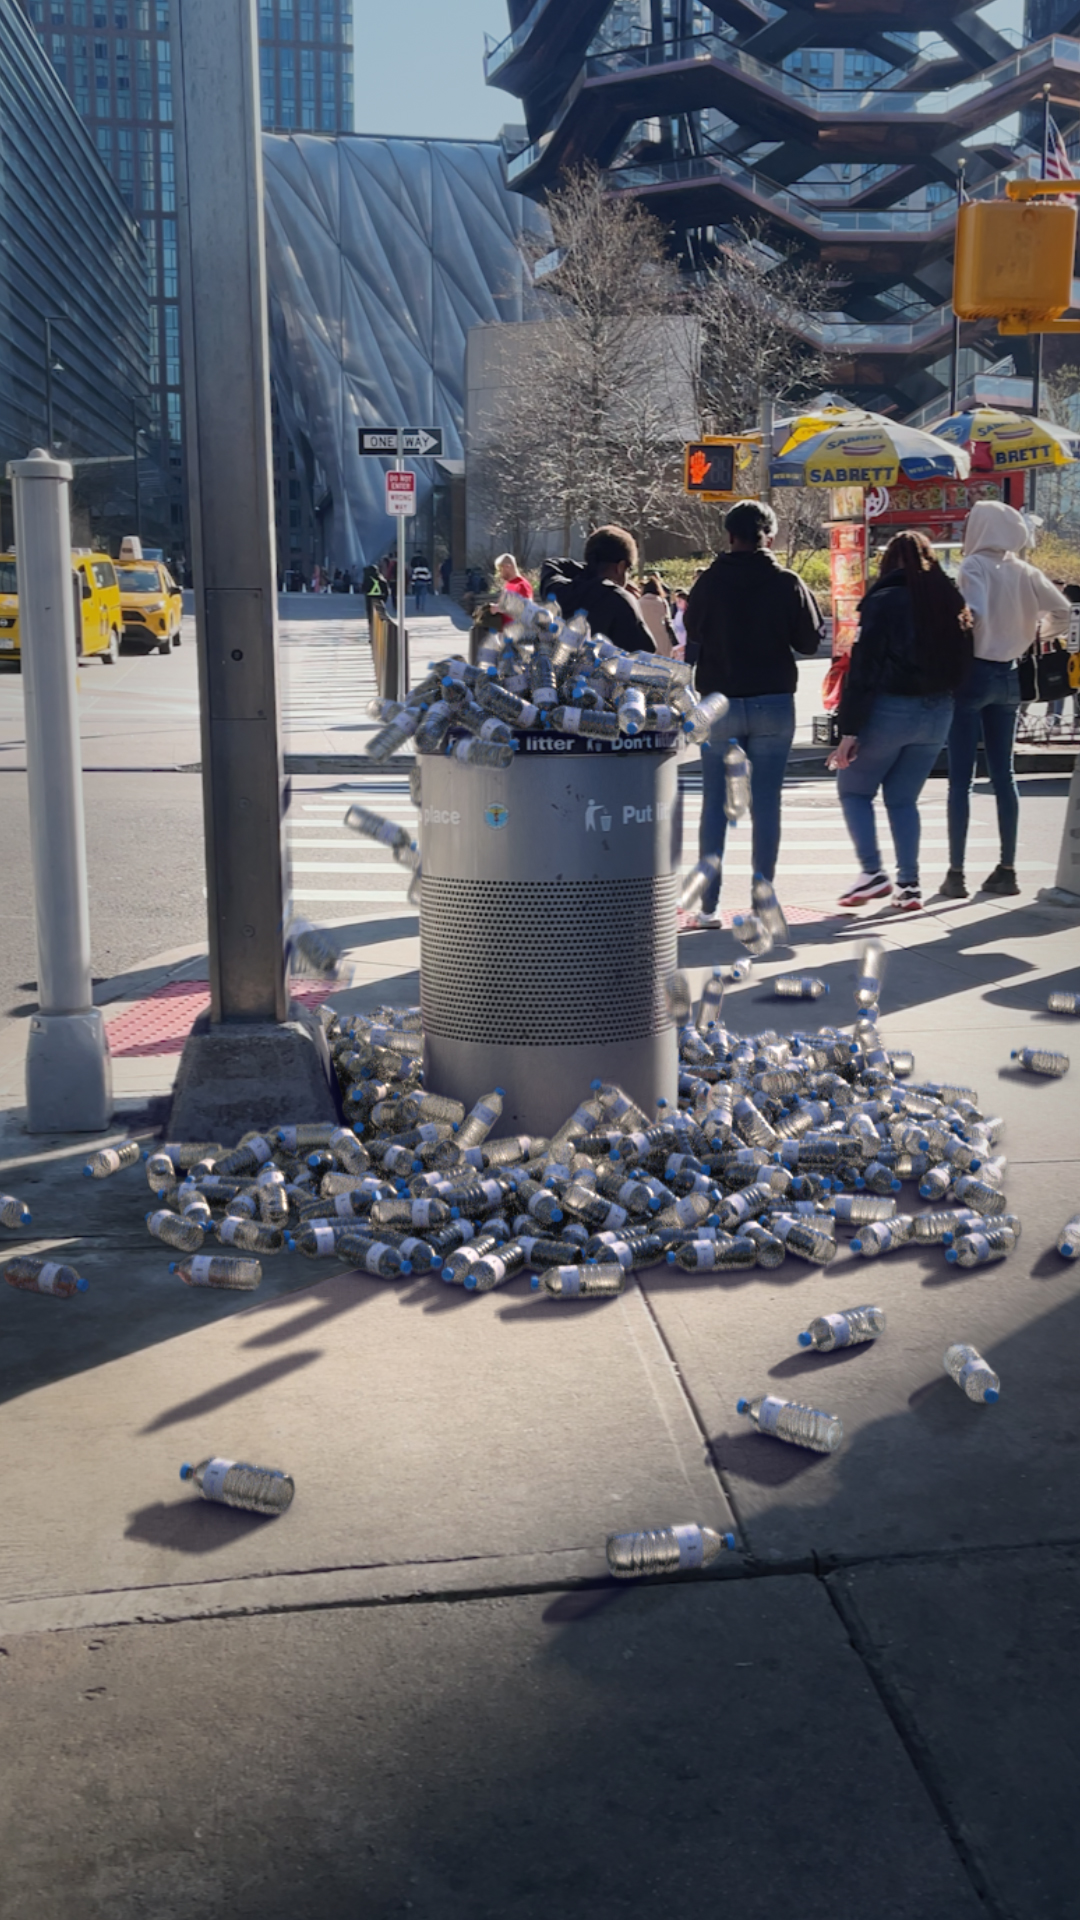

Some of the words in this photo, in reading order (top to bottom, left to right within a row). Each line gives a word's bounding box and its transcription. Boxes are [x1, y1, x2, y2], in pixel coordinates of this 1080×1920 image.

[370, 436, 394, 447] ONE
[405, 436, 430, 447] WAY
[996, 444, 1051, 464] BRETT
[810, 466, 895, 482] SABRETT
[526, 736, 575, 751] litter
[611, 735, 652, 750] Don't
[424, 804, 461, 826] place
[622, 804, 652, 824] Put
